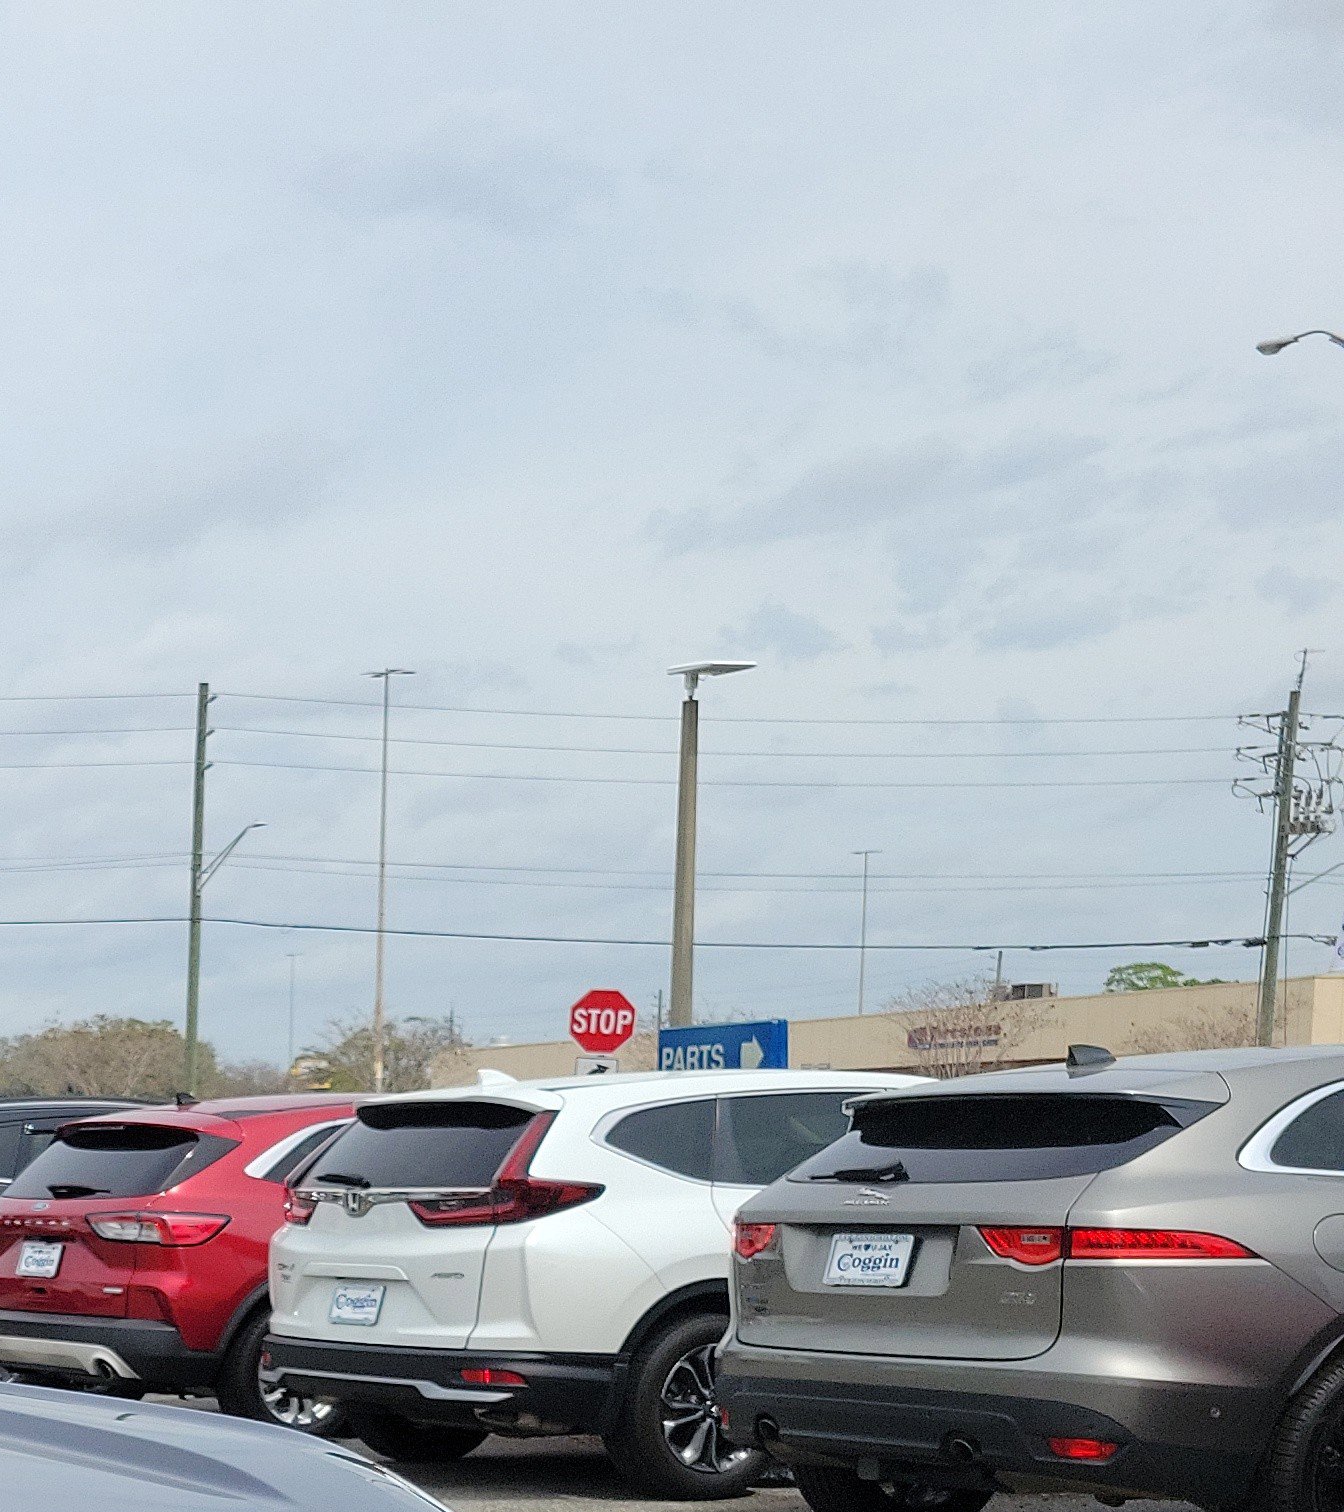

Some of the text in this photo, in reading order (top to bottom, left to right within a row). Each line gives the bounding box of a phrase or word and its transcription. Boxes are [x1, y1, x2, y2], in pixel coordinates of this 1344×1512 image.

[572, 1008, 633, 1035] STOP
[662, 1043, 726, 1070] PARTS
[837, 1253, 900, 1272] Coggin
